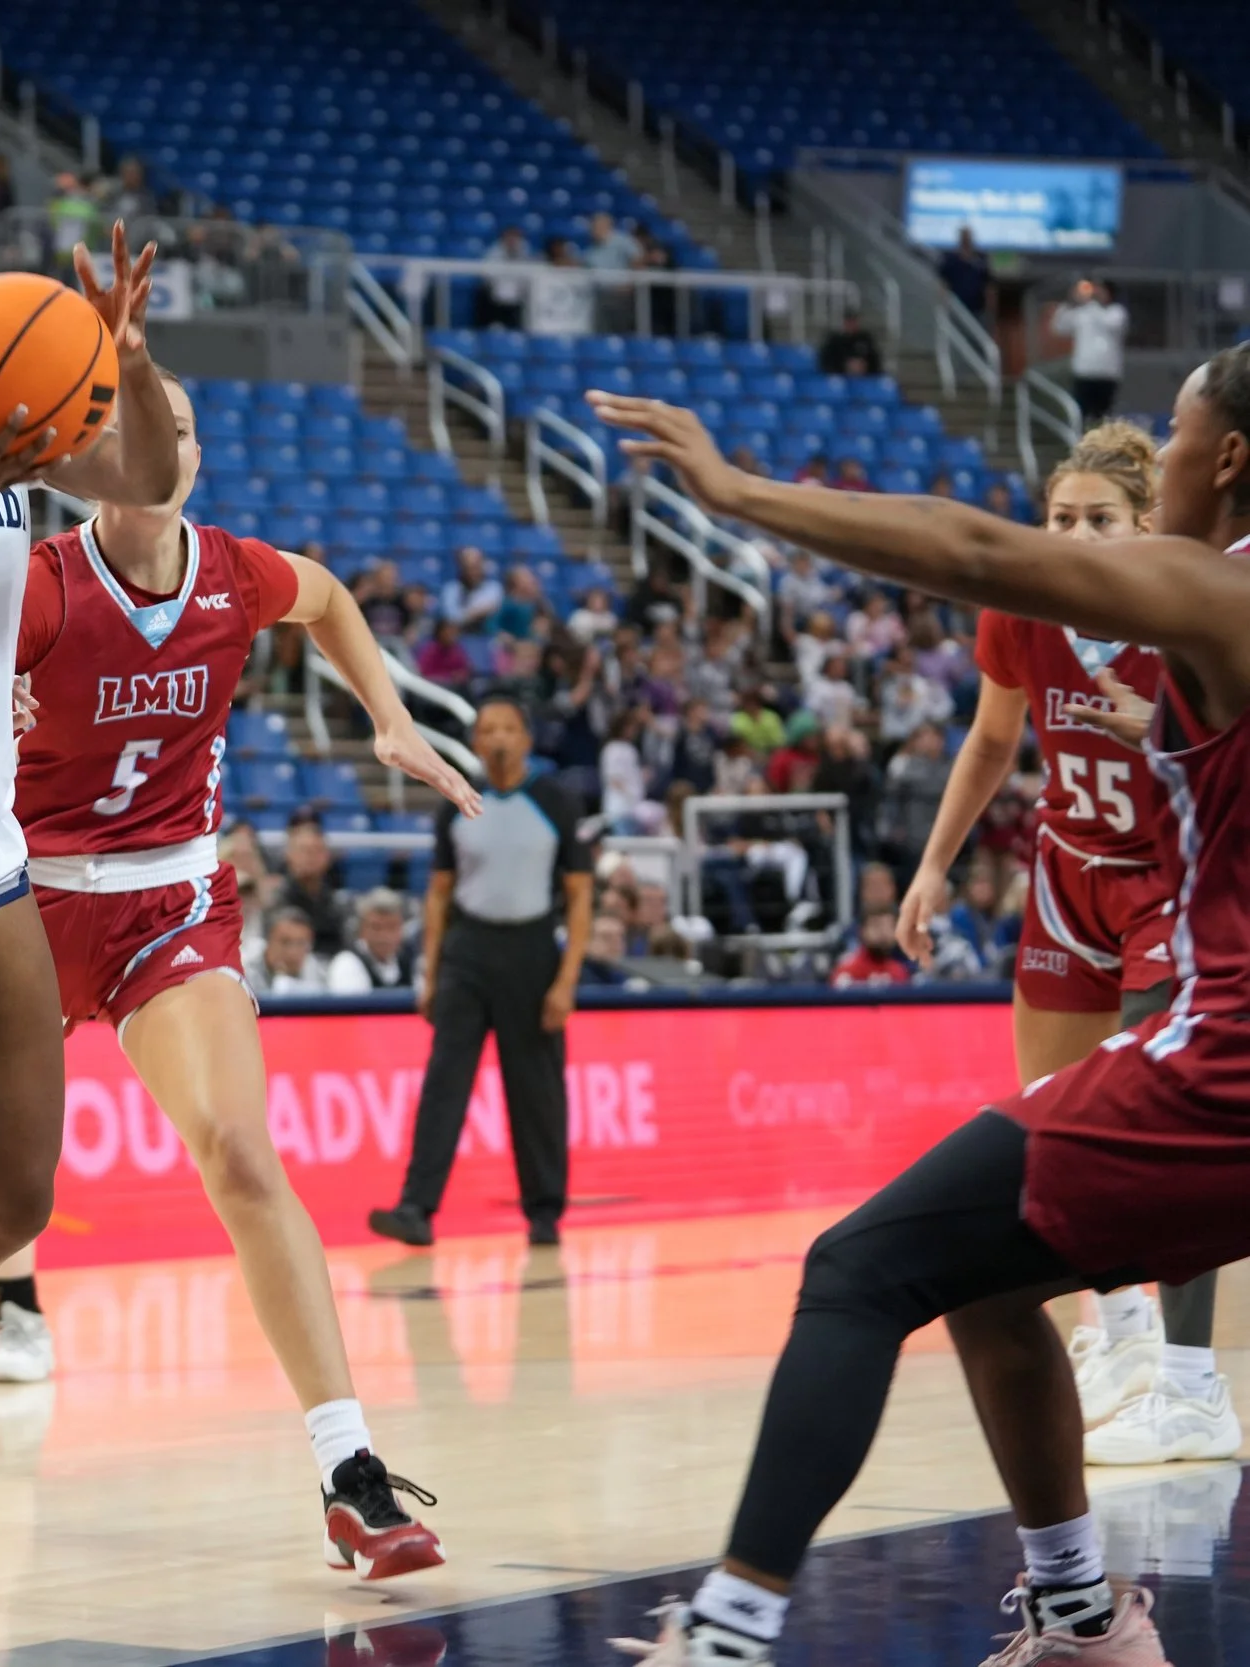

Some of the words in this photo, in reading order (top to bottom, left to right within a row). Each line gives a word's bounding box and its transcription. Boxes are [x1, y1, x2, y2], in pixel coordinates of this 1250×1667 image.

[195, 592, 231, 610] WCC
[93, 664, 209, 725] LMU
[91, 738, 163, 816] 5
[1057, 752, 1136, 834] 55
[1021, 946, 1069, 977] LMU
